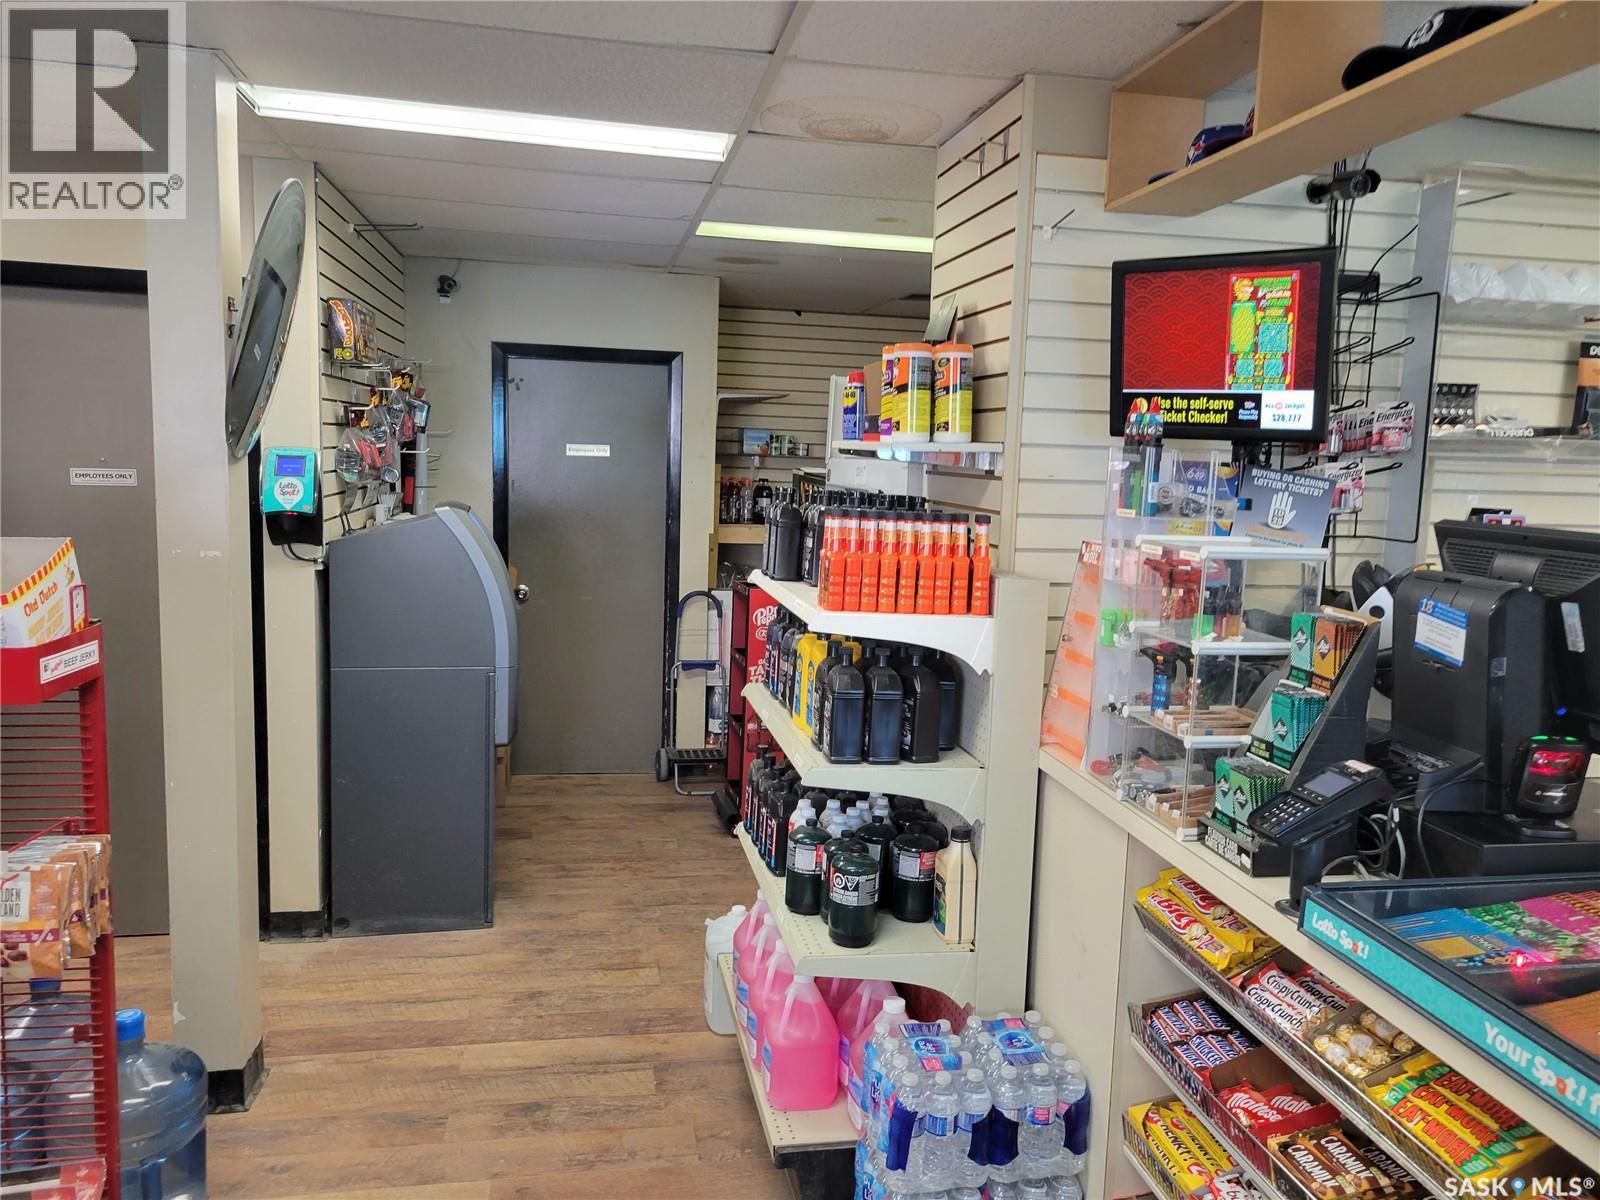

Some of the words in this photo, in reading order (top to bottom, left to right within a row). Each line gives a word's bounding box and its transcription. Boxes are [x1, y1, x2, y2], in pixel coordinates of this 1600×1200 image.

[1161, 410, 1187, 423] icket
[1188, 411, 1229, 424] Checker!
[1173, 397, 1188, 410] the
[1190, 397, 1234, 410] self-serve
[1376, 408, 1414, 423] Energizer
[1251, 468, 1281, 480] BUYING
[1282, 472, 1294, 482] OR
[1294, 475, 1330, 489] CASHING
[1253, 476, 1287, 490] LOTTERY
[1287, 481, 1324, 497] TICKETS?
[24, 598, 39, 617] Old
[39, 581, 58, 605] Dutch
[64, 656, 79, 669] BEEF
[79, 649, 96, 663] JERKY
[1312, 911, 1338, 940] Lotto
[1338, 929, 1369, 960] Spot!
[1247, 986, 1303, 1029] CrispyCrunch
[1267, 974, 1321, 1016] CrispyCrunch
[1484, 1020, 1532, 1068] Your
[1531, 1054, 1588, 1107] Spot!
[1411, 1083, 1500, 1150] EAT-MORE
[1433, 1070, 1523, 1132] EAT-MORE
[1391, 1096, 1481, 1168] EAT-MORE
[1287, 1145, 1339, 1189] CARAMILK
[1320, 1135, 1374, 1179] CARAMILK
[1360, 1146, 1416, 1184] CARAMILK
